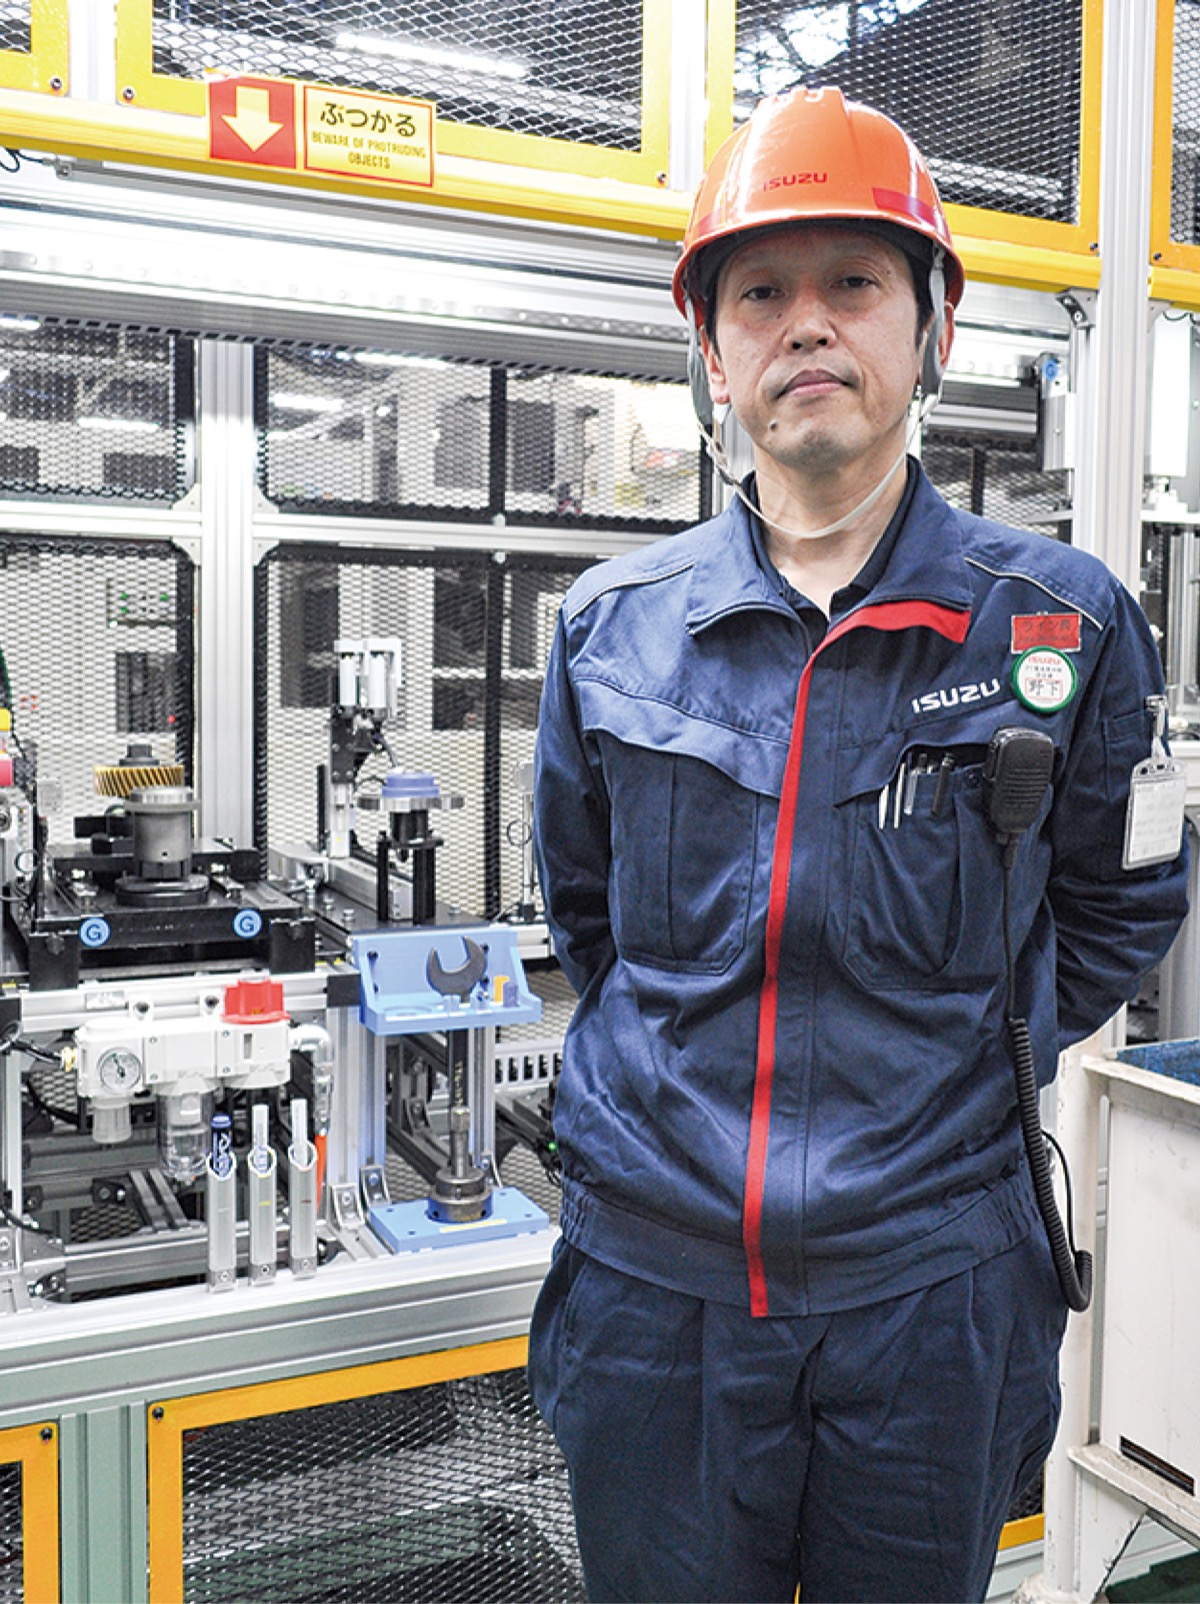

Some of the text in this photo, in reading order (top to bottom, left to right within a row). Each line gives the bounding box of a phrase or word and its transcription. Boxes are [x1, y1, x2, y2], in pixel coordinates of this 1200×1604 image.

[320, 102, 416, 138] ぶつかる
[311, 131, 427, 159] BEWARE OF PROTRUDING
[348, 151, 391, 170] OBJECTS
[763, 172, 828, 192] ISUZU
[911, 678, 1001, 714] ISUZU
[86, 923, 102, 942] G
[239, 915, 255, 934] G
